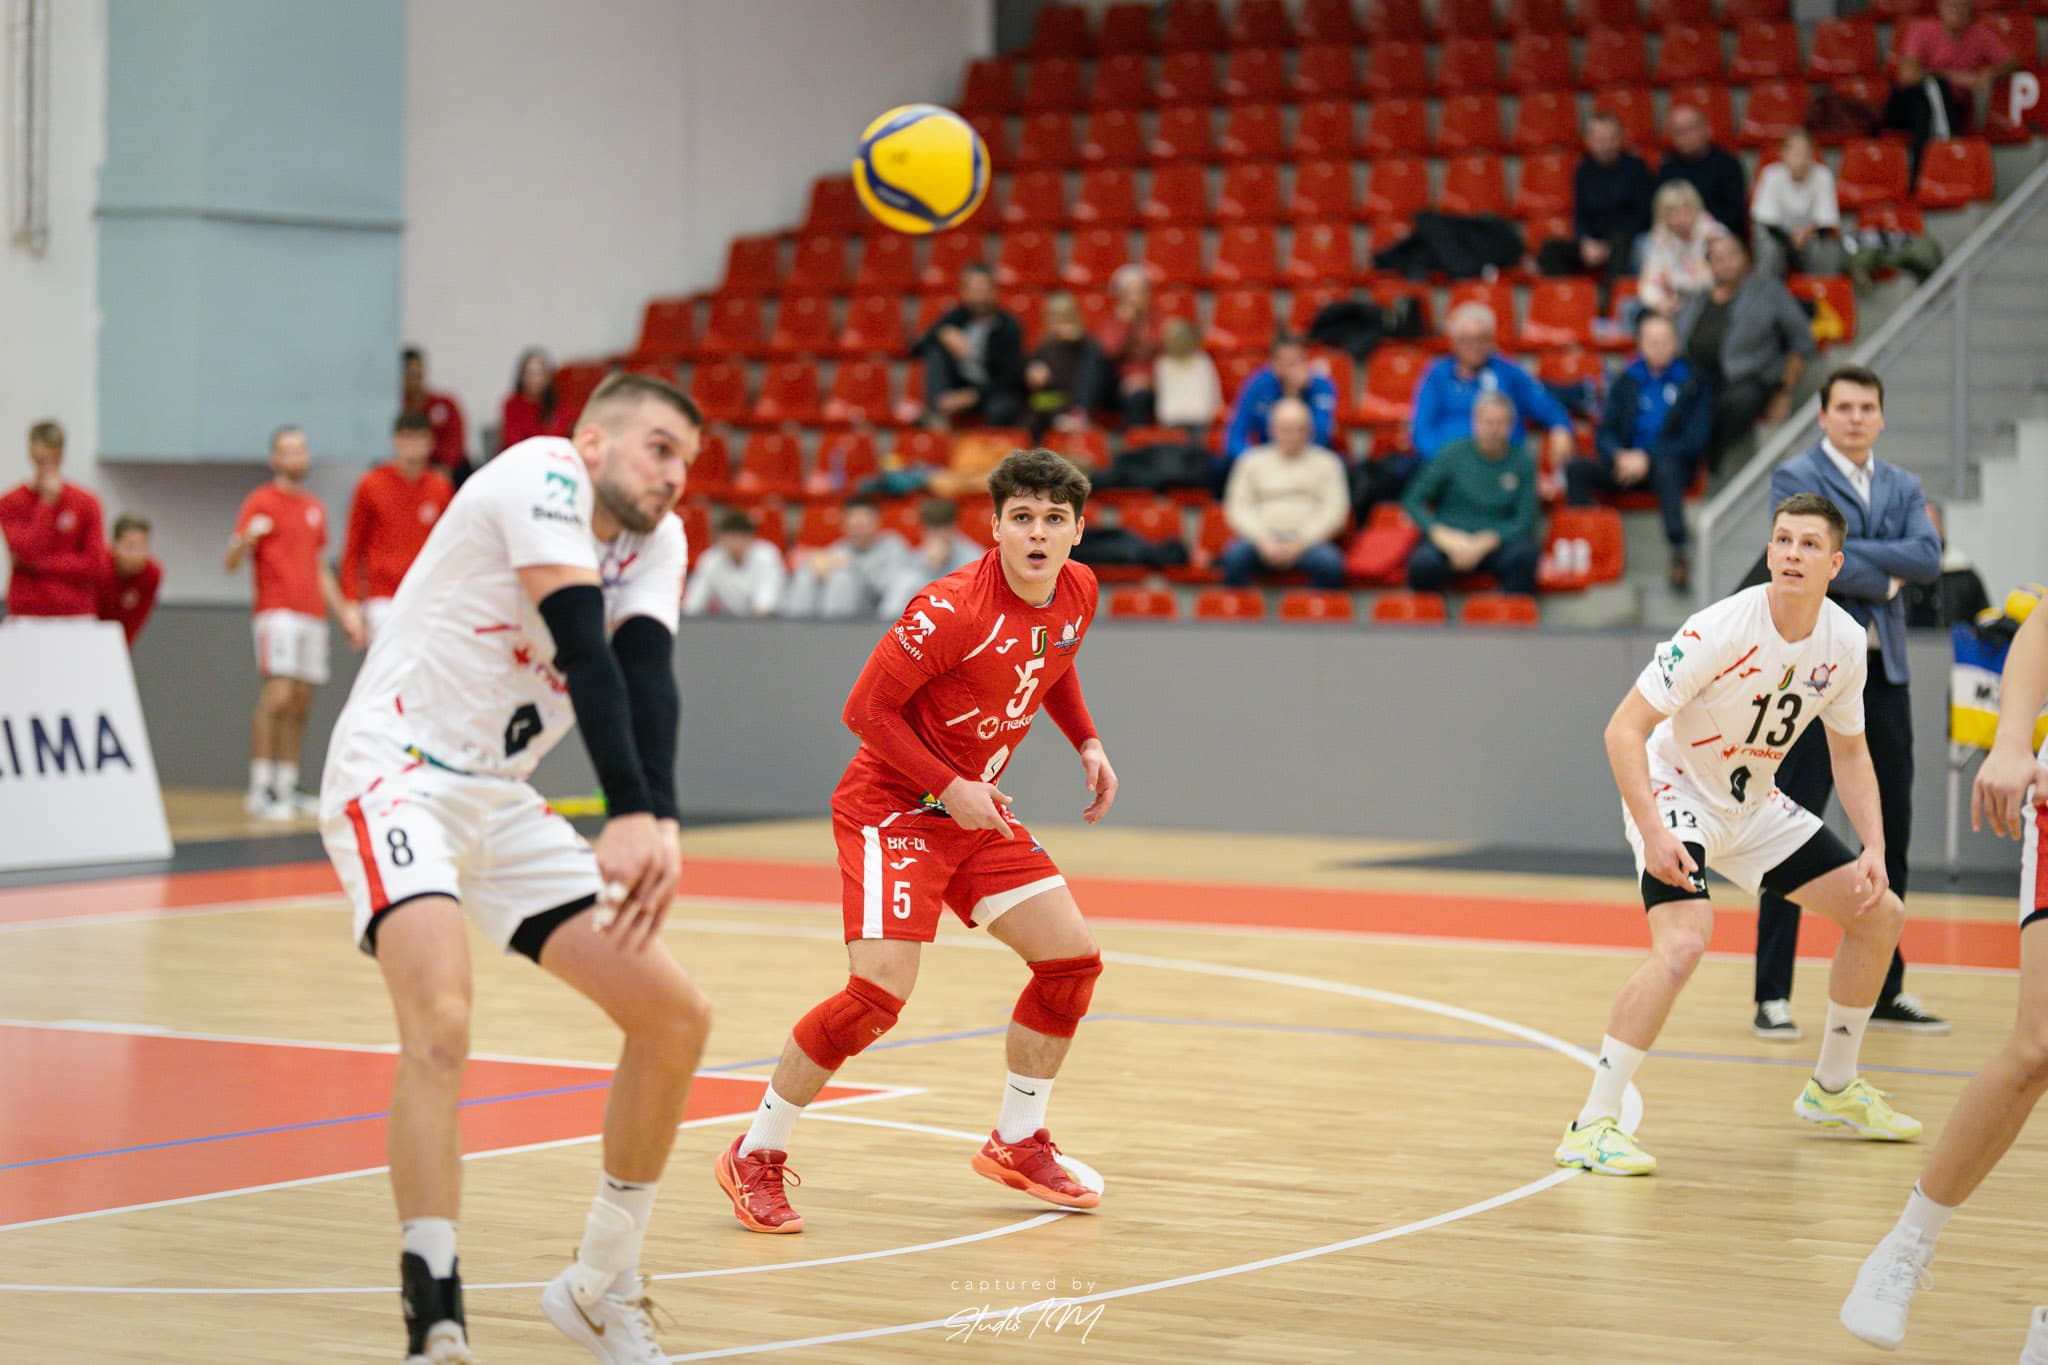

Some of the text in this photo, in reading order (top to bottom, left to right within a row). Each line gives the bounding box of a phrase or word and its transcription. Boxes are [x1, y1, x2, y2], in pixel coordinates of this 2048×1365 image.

[1746, 693, 1802, 746] 13
[0, 715, 133, 776] IMA
[1666, 810, 1698, 828] 13
[387, 828, 414, 867] 8
[893, 881, 911, 919] 5
